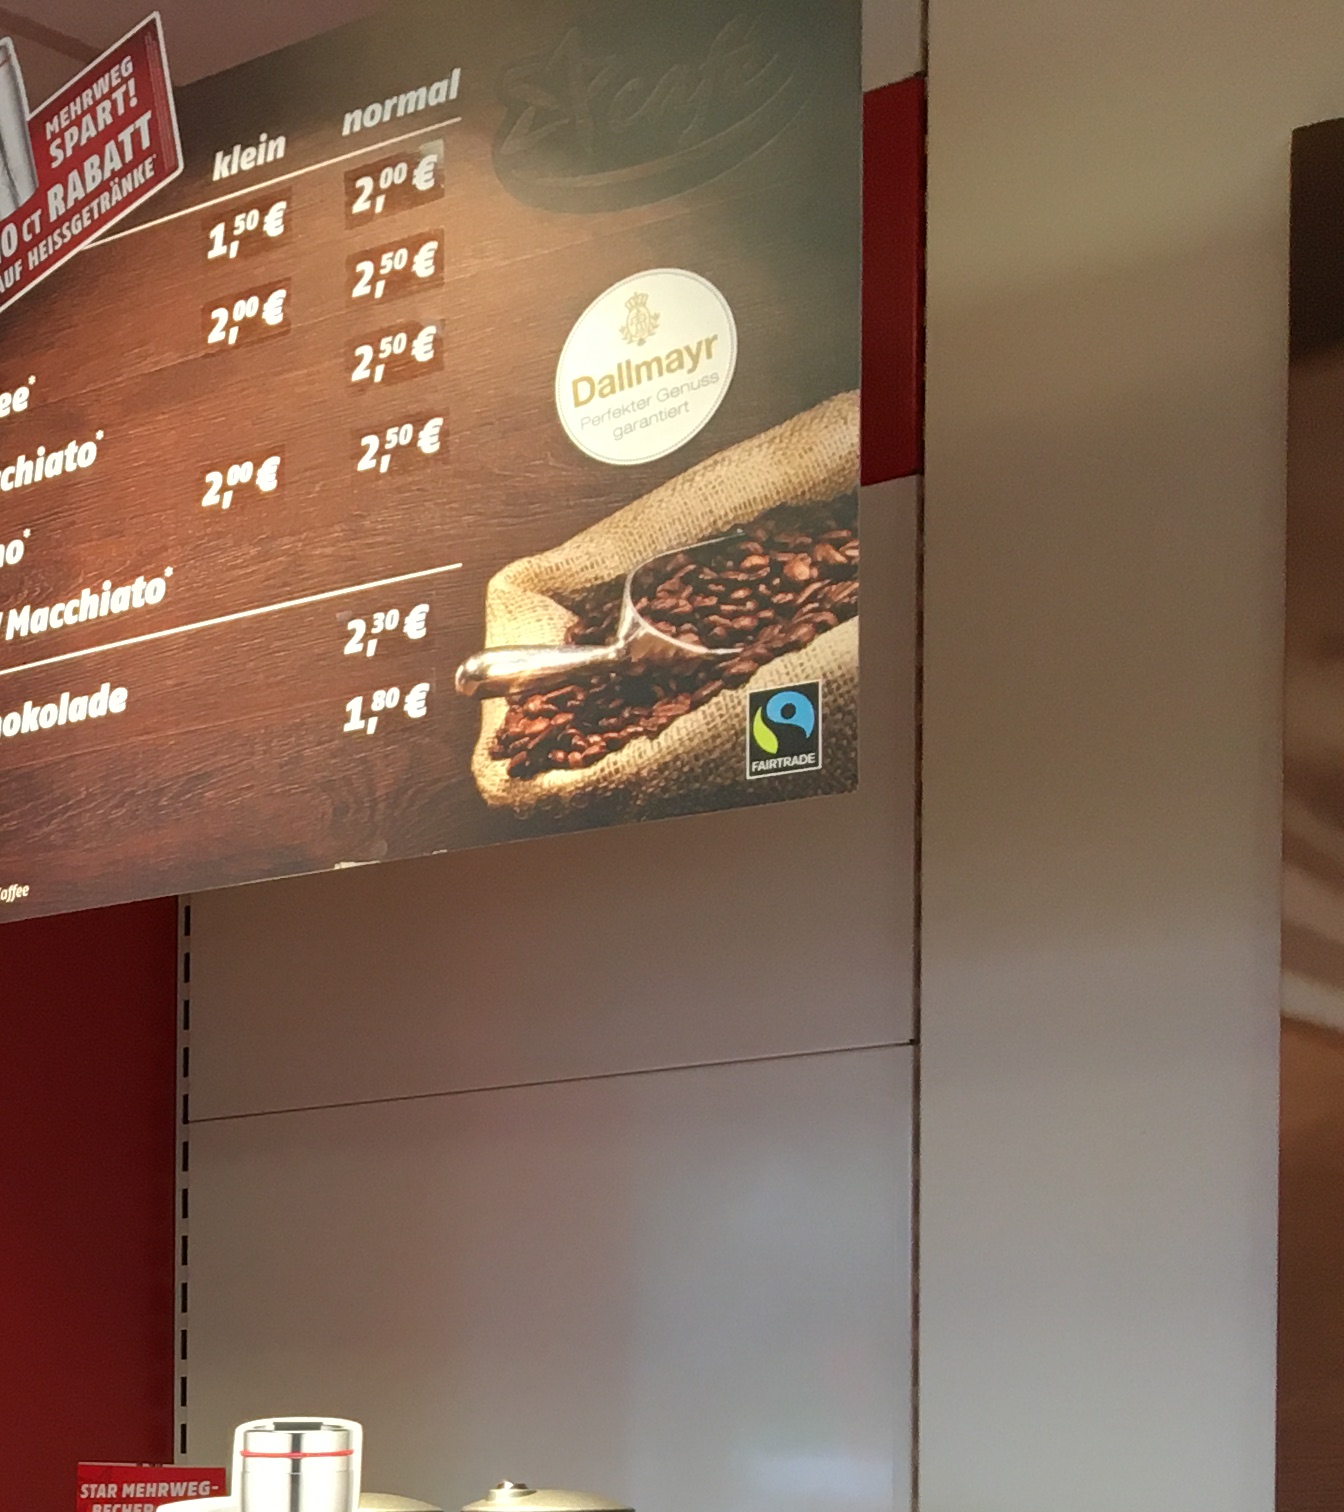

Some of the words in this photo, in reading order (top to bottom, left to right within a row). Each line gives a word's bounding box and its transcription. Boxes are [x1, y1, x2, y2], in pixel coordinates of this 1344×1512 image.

[44, 55, 134, 140] MEHRWEG
[49, 81, 139, 169] SPART!
[213, 134, 285, 182] klein
[342, 68, 461, 136] normal
[21, 212, 42, 245] CT
[46, 111, 154, 222] RABATT
[571, 334, 718, 408] Dallmayr
[580, 395, 652, 430] Perfekter
[656, 372, 720, 402] Genuss
[613, 401, 690, 441] garantiert
[752, 752, 816, 772] FAIRTRADE
[80, 1483, 117, 1498] STAR
[122, 1480, 219, 1498] MEHRWEG-
